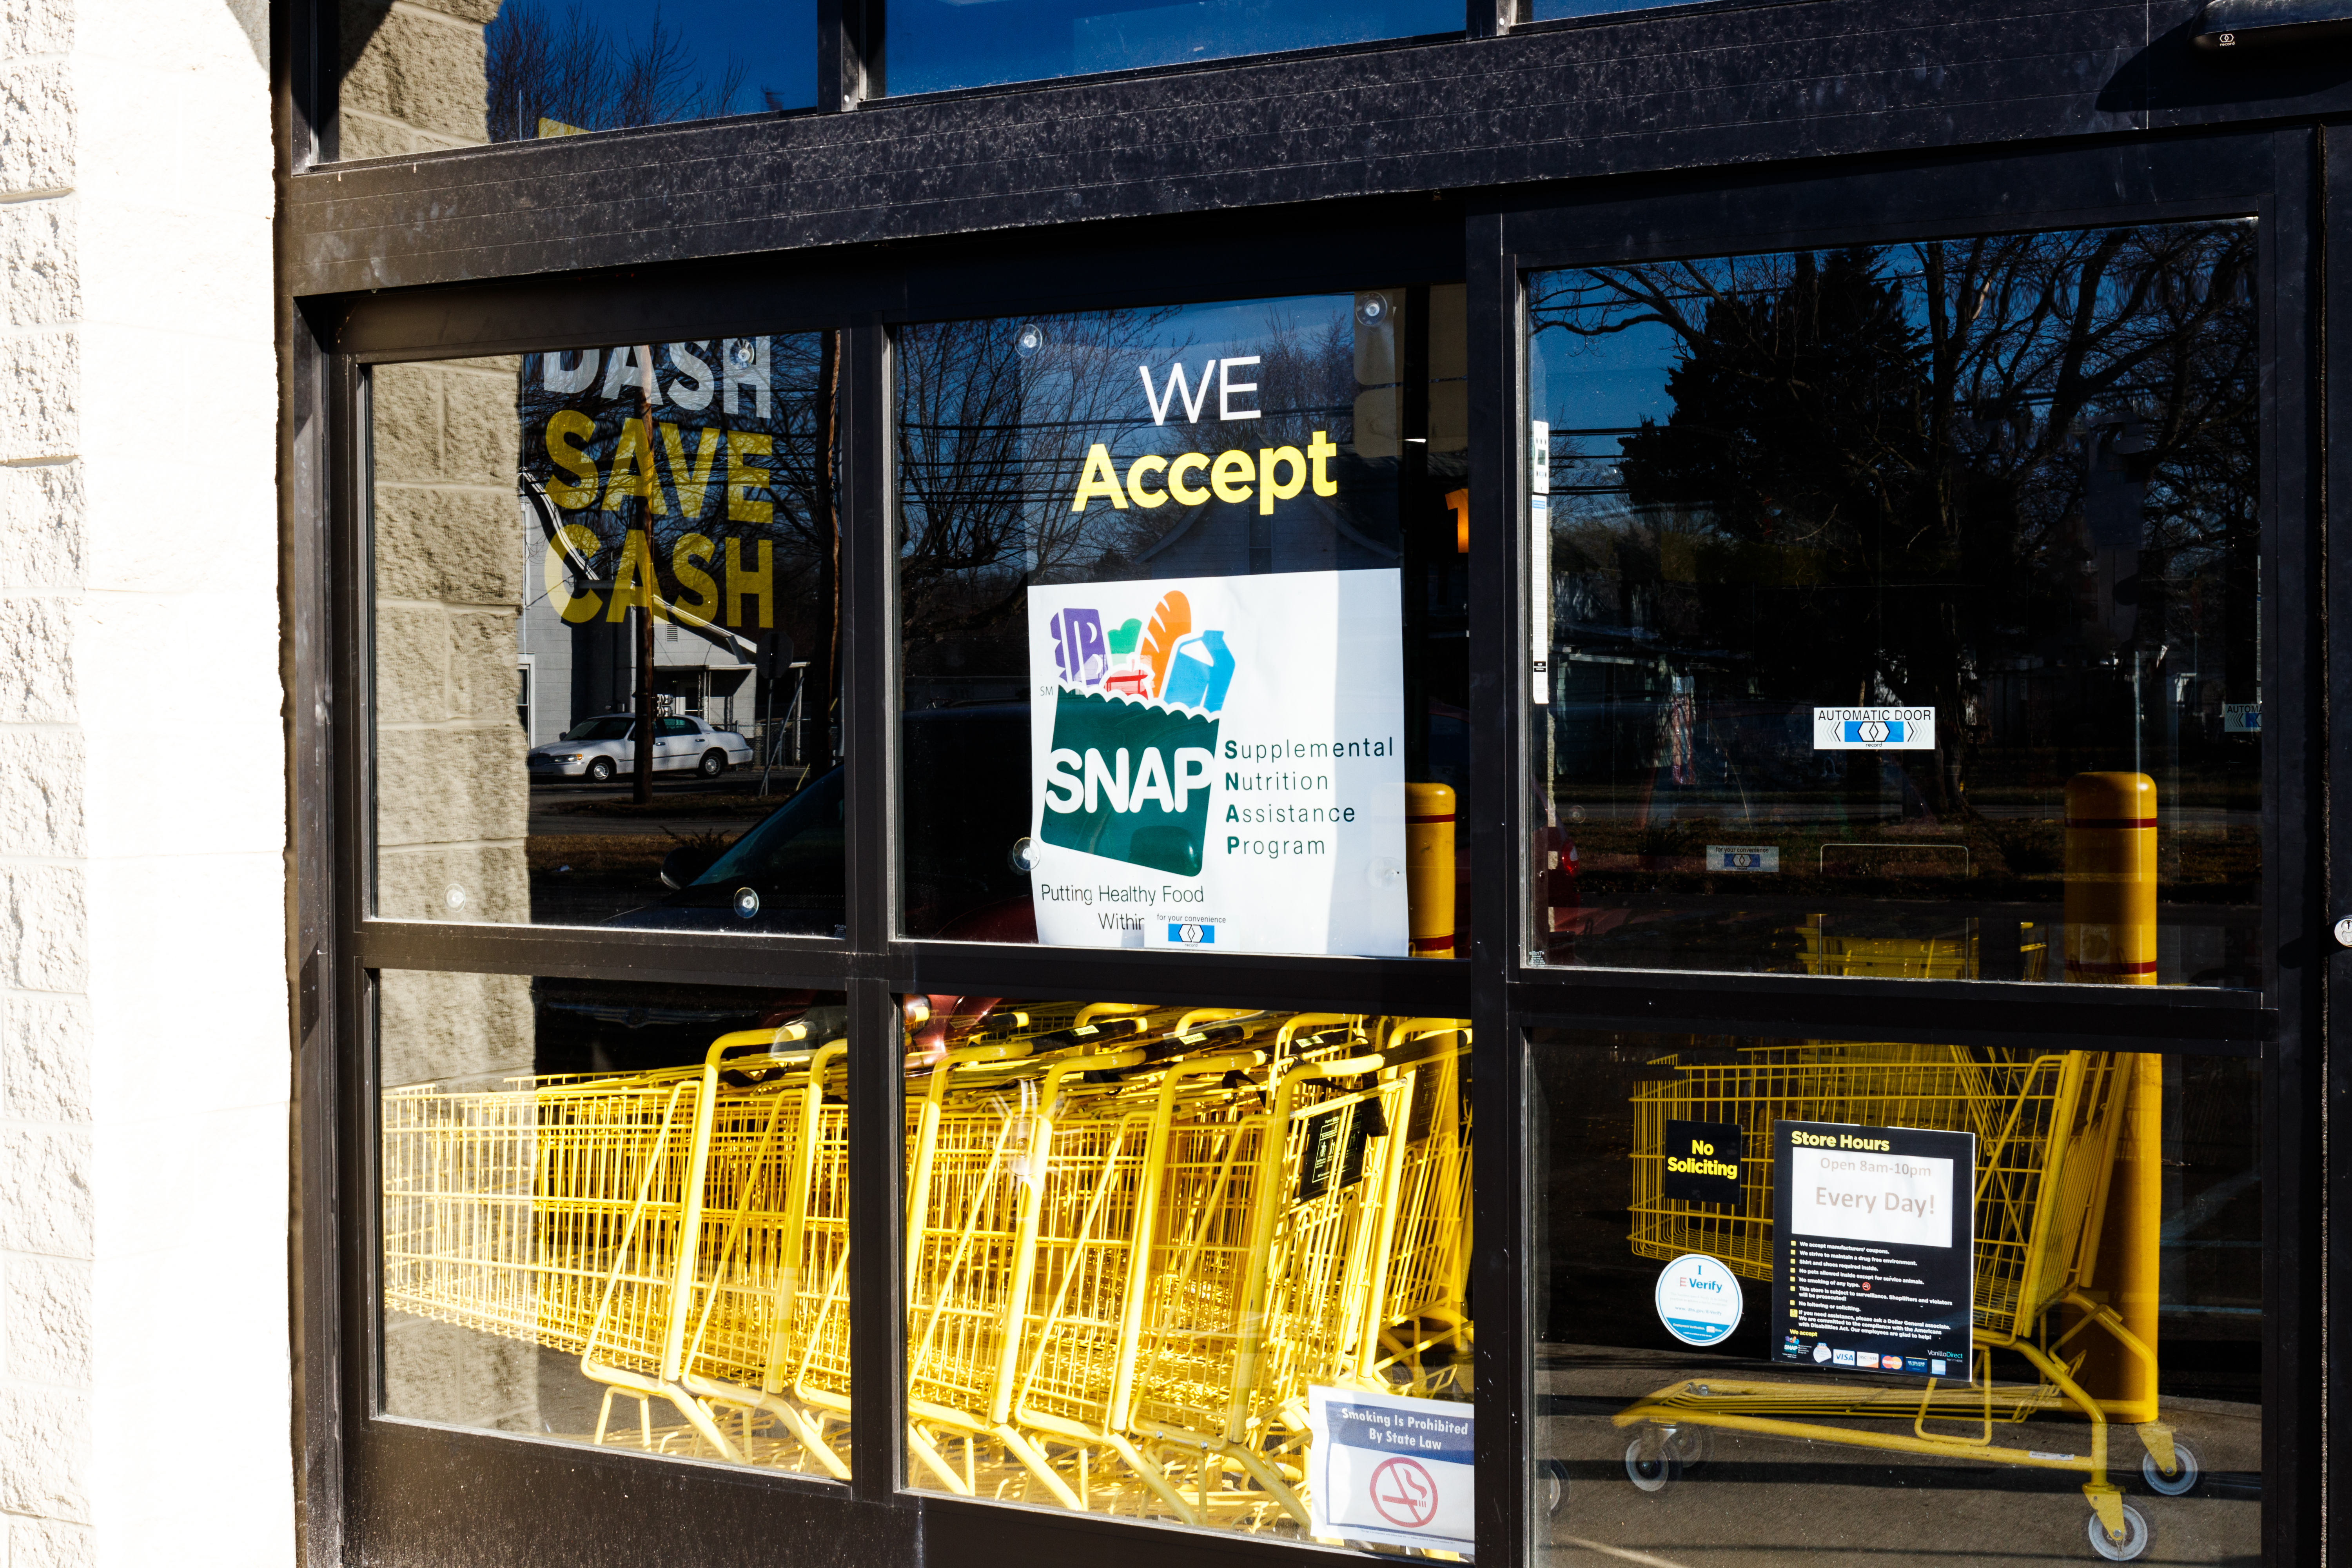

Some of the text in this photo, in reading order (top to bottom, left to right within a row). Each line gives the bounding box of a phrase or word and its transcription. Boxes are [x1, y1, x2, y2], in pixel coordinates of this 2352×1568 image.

[543, 336, 771, 419] DASH
[1139, 356, 1261, 426] WE
[544, 410, 773, 524] SAVE
[1072, 431, 1337, 515] Accept
[544, 524, 773, 628] CASH
[1040, 686, 1054, 696] SM
[1818, 710, 1931, 721] AUTOMATIC DOOR
[1224, 737, 1393, 763] Supplemental
[1045, 747, 1215, 813] SNAP
[1225, 772, 1328, 791] Nutrition
[1225, 804, 1356, 823] Assistance
[1227, 836, 1325, 859] Program
[1041, 884, 1204, 906] Putting Healthy Food
[1692, 1140, 1714, 1156] No
[1791, 1131, 1890, 1151] Store Hours
[1667, 1157, 1737, 1180] Soliciting
[1820, 1158, 1931, 1178] Open 8am-10pm
[1816, 1187, 1935, 1218] Every Day!
[1697, 1265, 1702, 1275] I
[1835, 1353, 1853, 1361] VISA
[1927, 1349, 1963, 1359] VanillaDirect
[1341, 1408, 1468, 1435] Smoking Is Prohibited
[1369, 1428, 1442, 1450] By State Law
